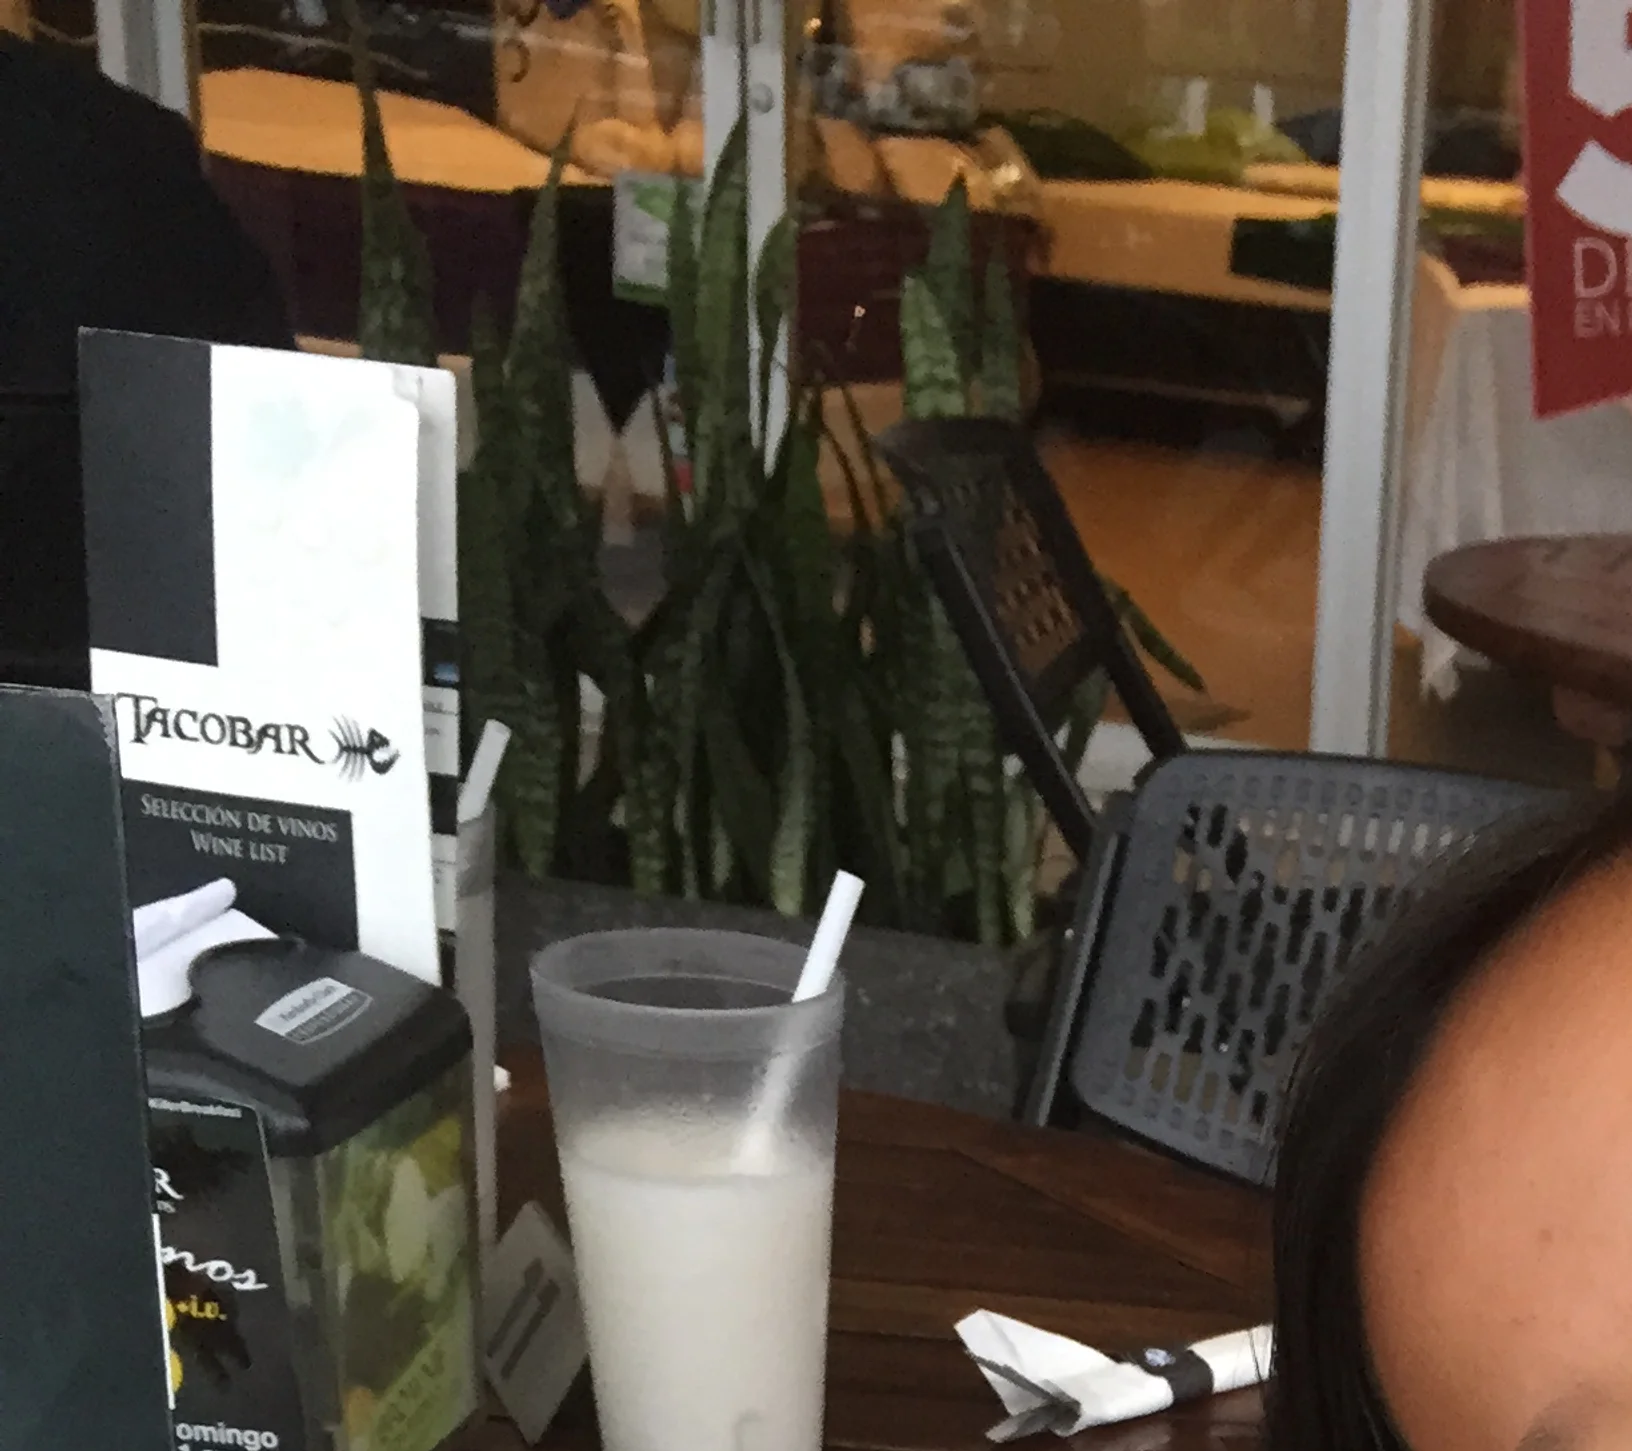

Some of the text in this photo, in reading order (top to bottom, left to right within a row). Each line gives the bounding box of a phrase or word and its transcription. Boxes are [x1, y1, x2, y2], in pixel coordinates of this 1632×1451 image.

[1573, 298, 1622, 339] EN
[116, 692, 326, 764] TACOBAR
[247, 811, 273, 834] DE
[277, 816, 338, 843] VINOS
